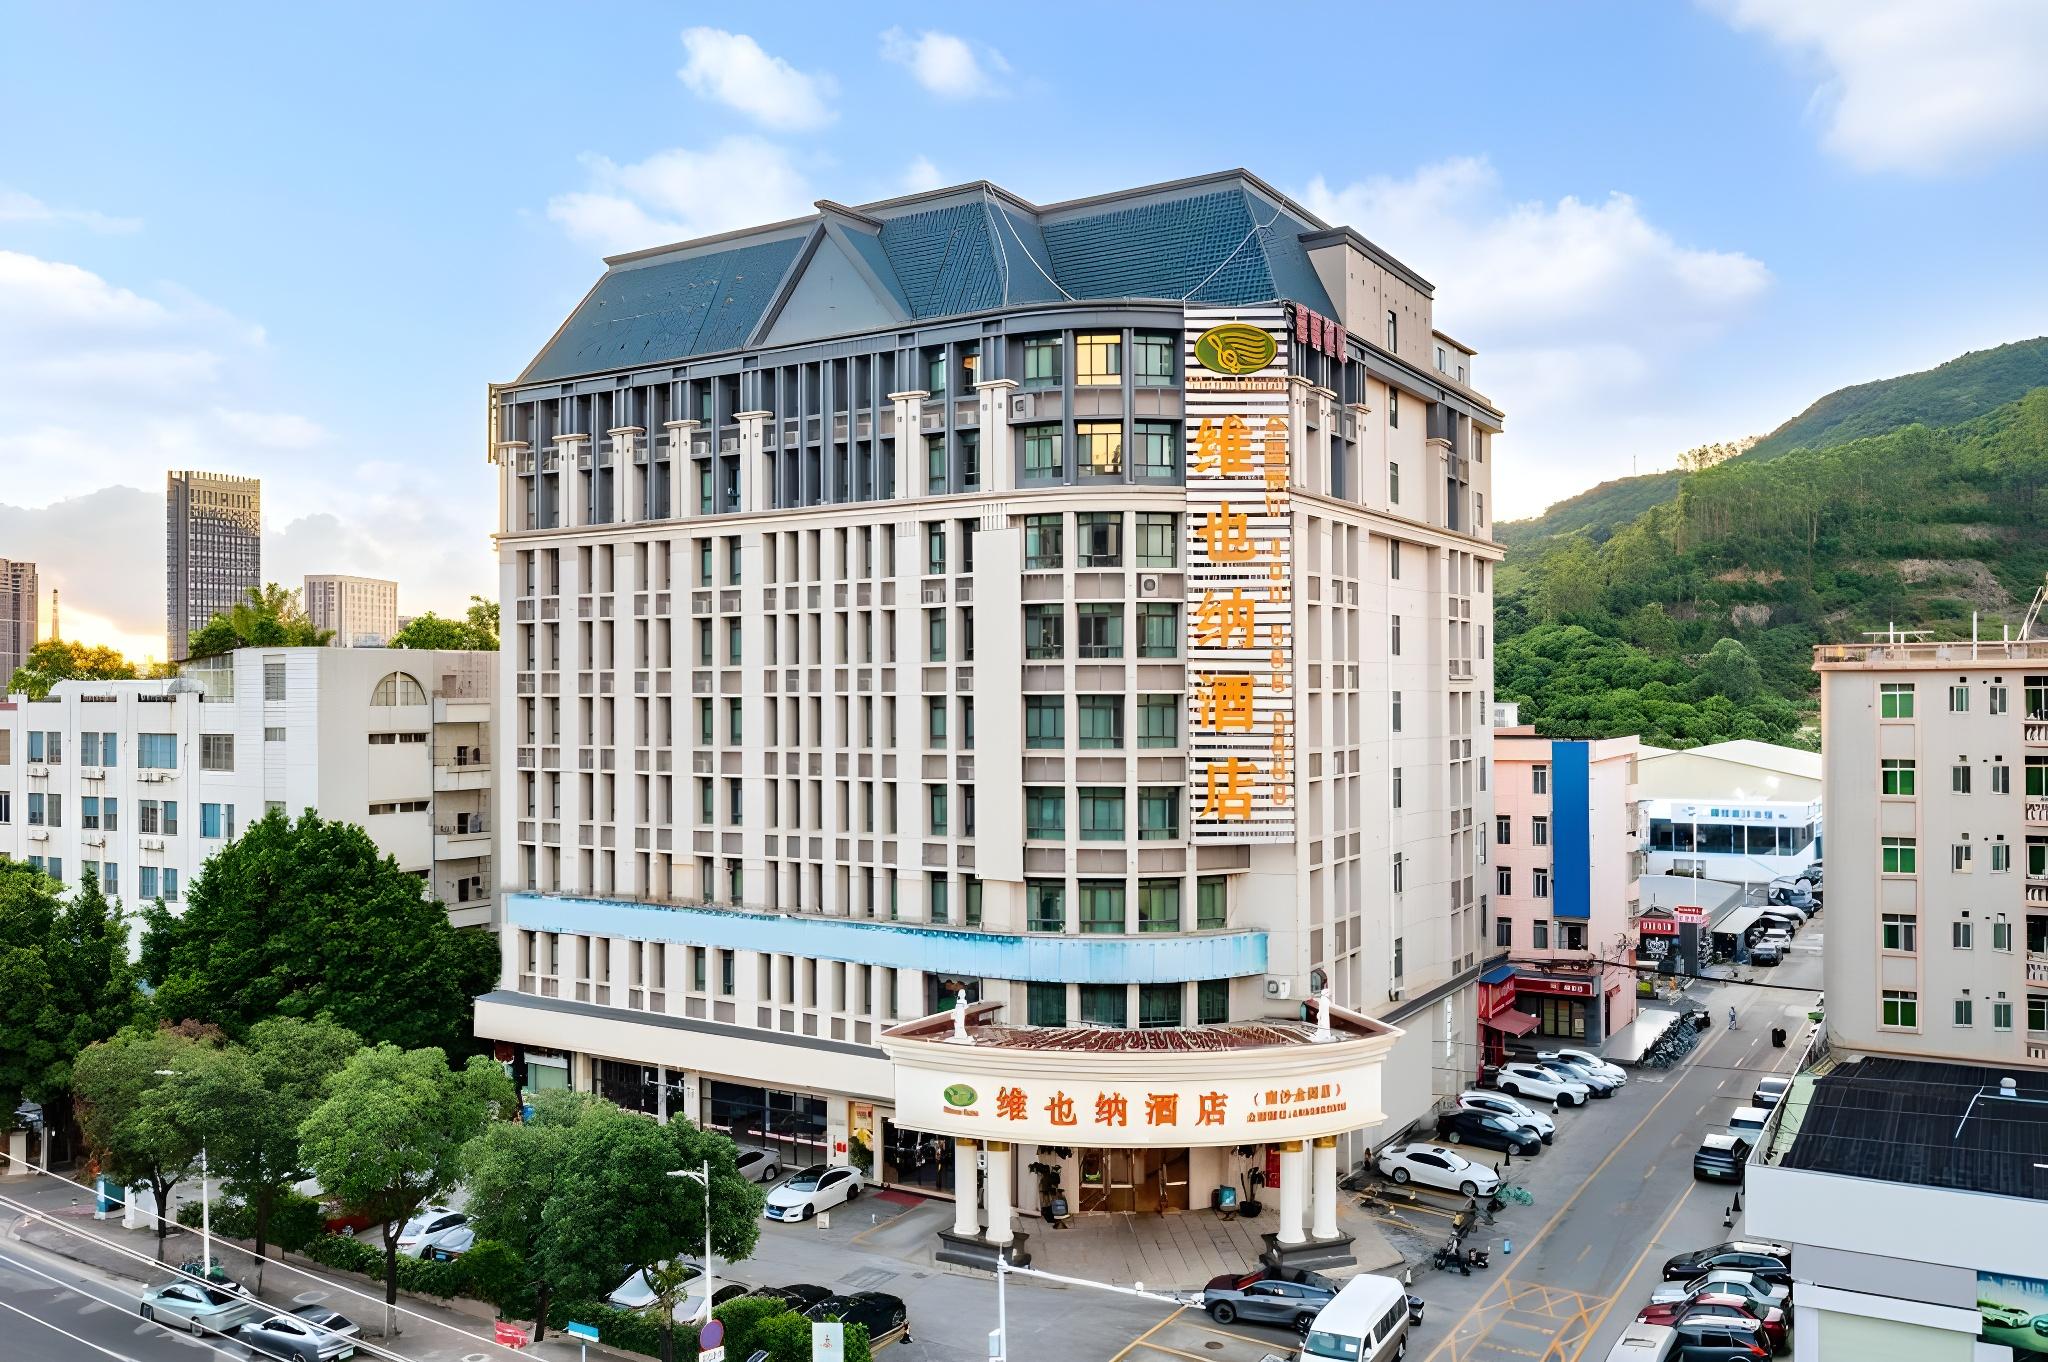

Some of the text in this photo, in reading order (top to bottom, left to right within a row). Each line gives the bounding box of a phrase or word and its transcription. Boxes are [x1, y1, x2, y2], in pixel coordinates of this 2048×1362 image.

[996, 1086, 1228, 1127] 维也纳酒店
